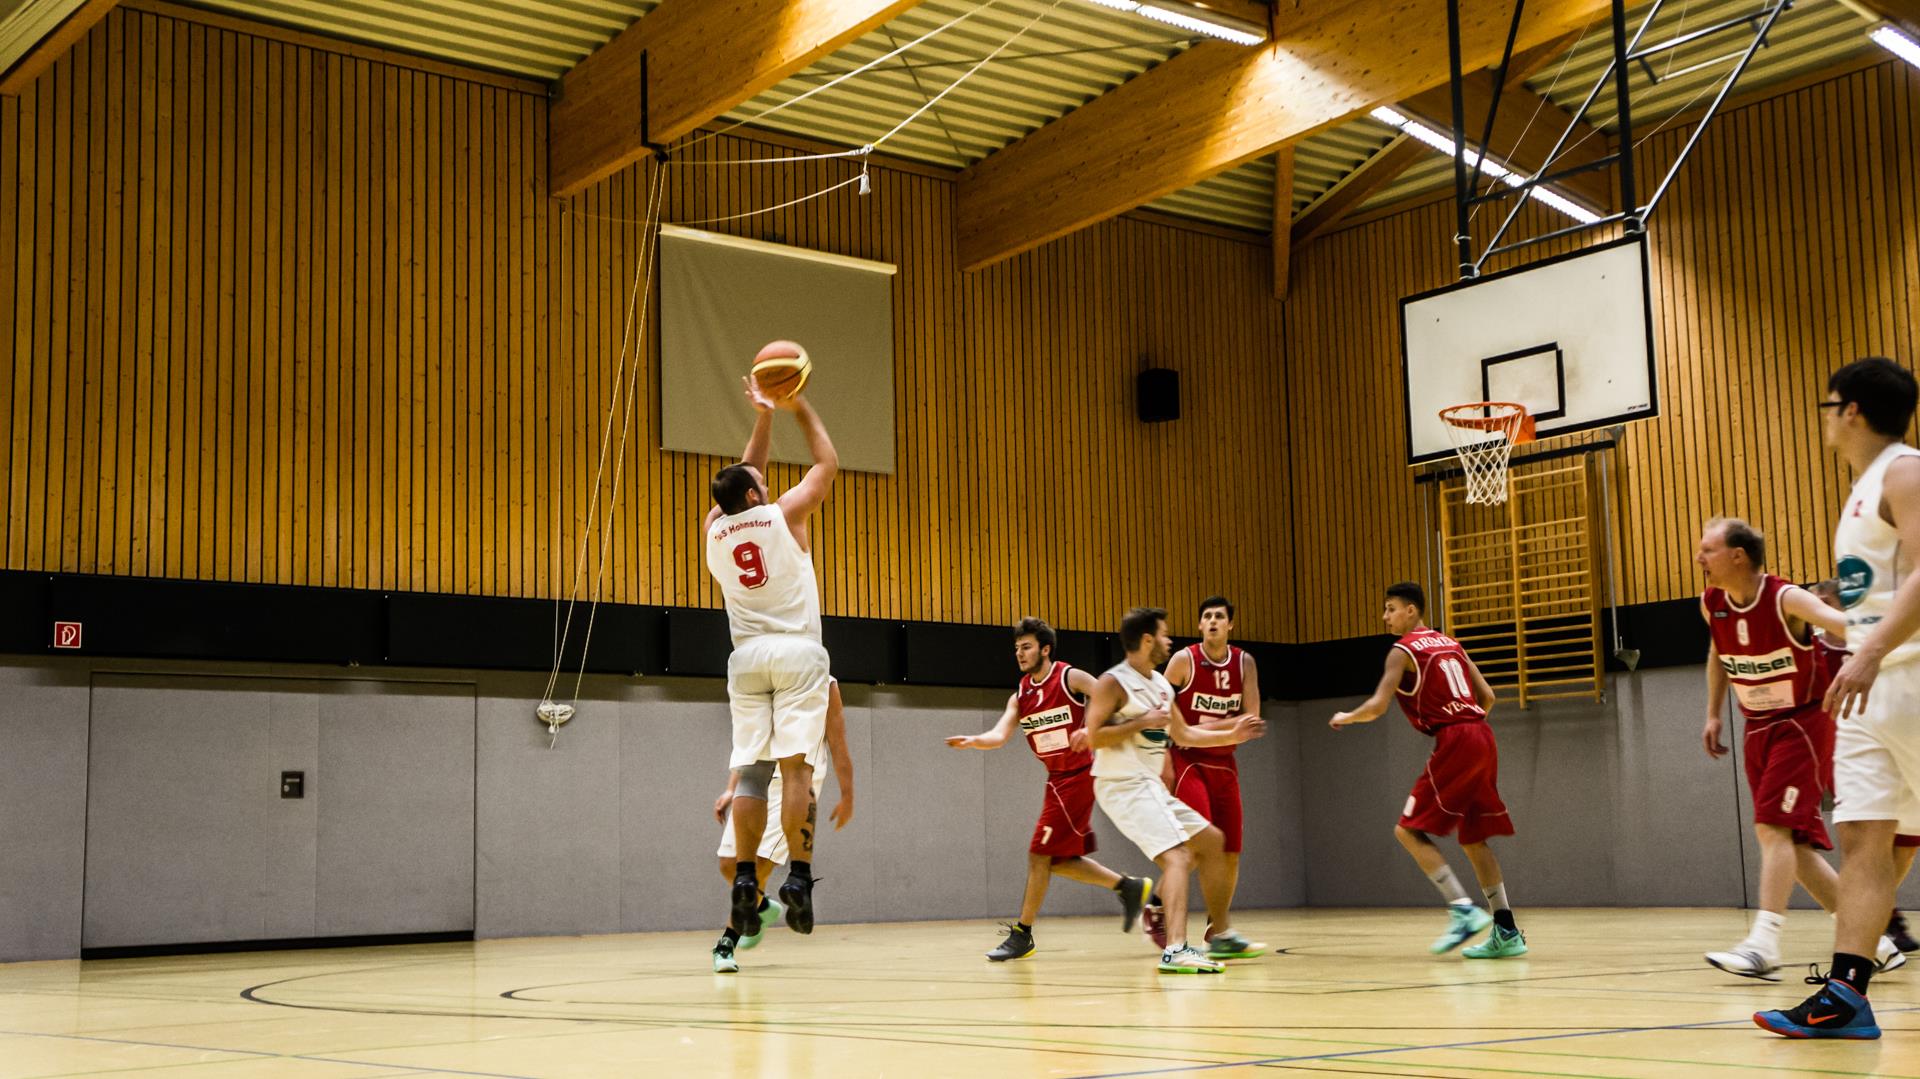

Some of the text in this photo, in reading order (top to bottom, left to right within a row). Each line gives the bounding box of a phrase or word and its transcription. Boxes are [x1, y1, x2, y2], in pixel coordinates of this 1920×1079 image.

[732, 541, 768, 590] 9
[1213, 669, 1231, 690] 12
[1439, 658, 1471, 698] 10
[1781, 785, 1799, 813] 9
[1041, 825, 1053, 845] 7
